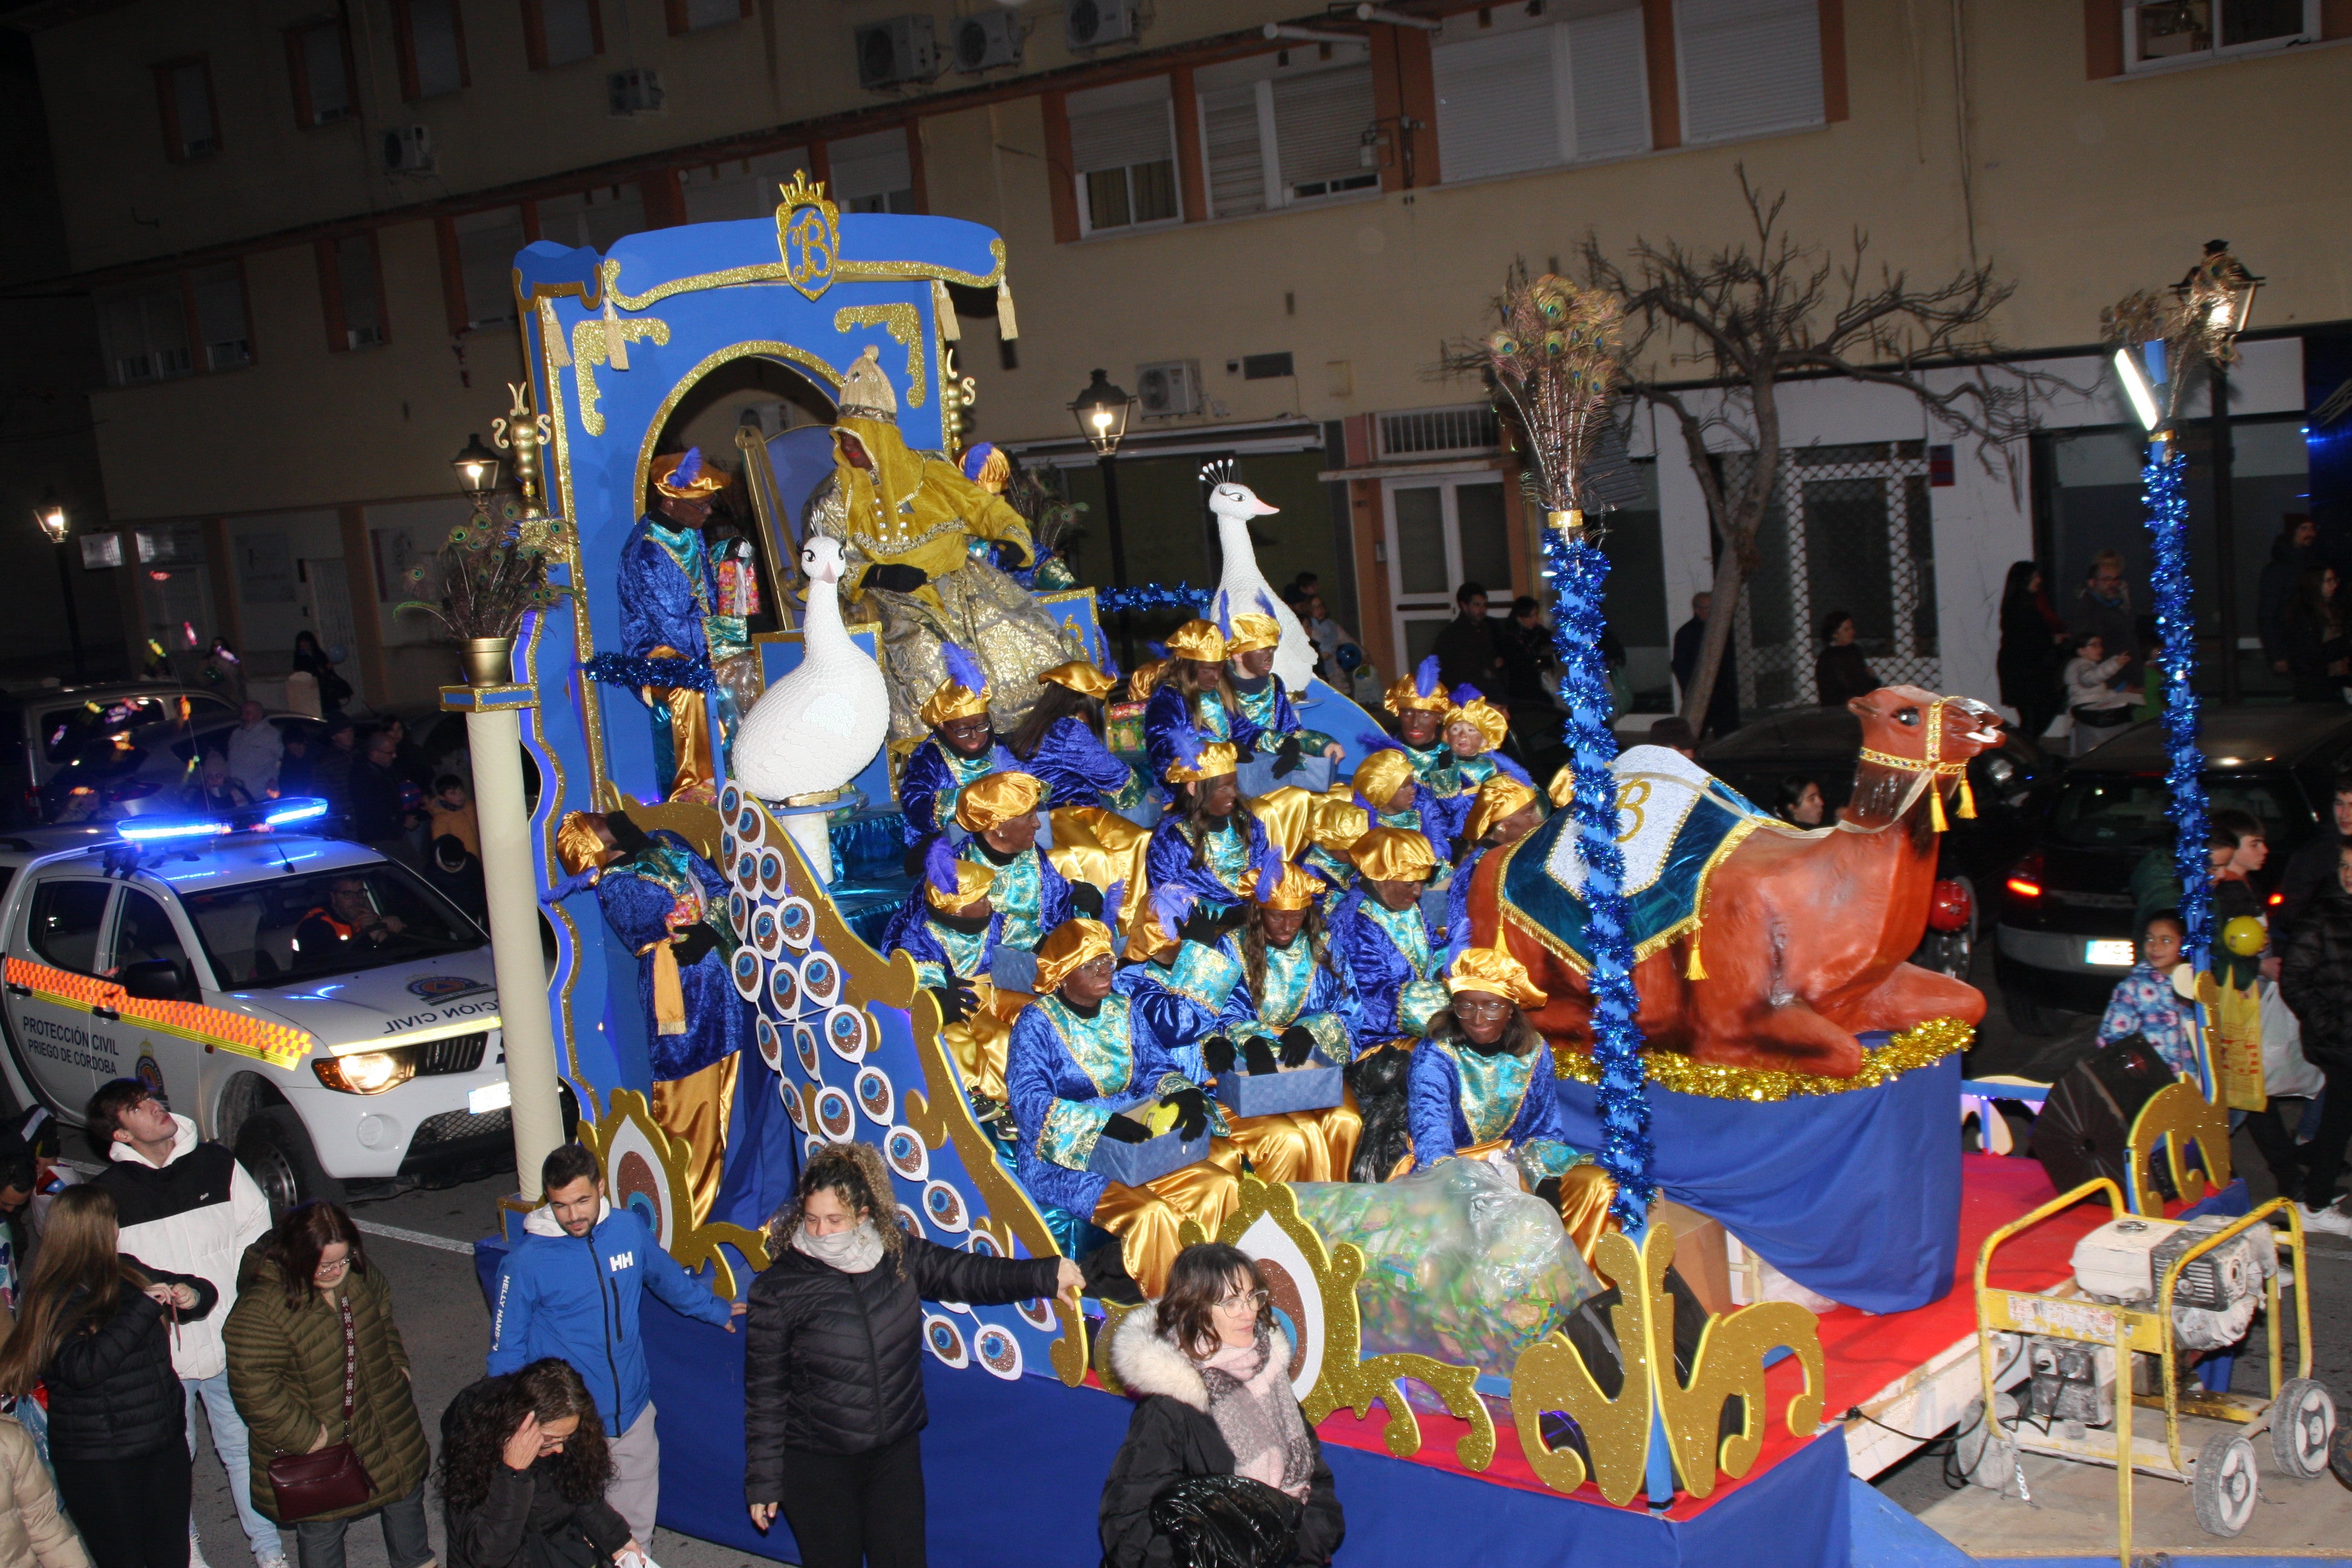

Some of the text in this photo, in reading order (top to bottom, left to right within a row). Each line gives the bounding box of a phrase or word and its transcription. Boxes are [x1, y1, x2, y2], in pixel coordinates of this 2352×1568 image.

[789, 211, 833, 283] B
[1615, 777, 1652, 843] B
[23, 1016, 119, 1056] PROTECCIÓN CIVIL
[28, 1039, 59, 1059] PRIEGO
[60, 1047, 73, 1063] DE
[74, 1050, 117, 1076] CÓRDOBA
[609, 1251, 633, 1272] HH
[492, 1275, 511, 1351] HELLY HANSN
